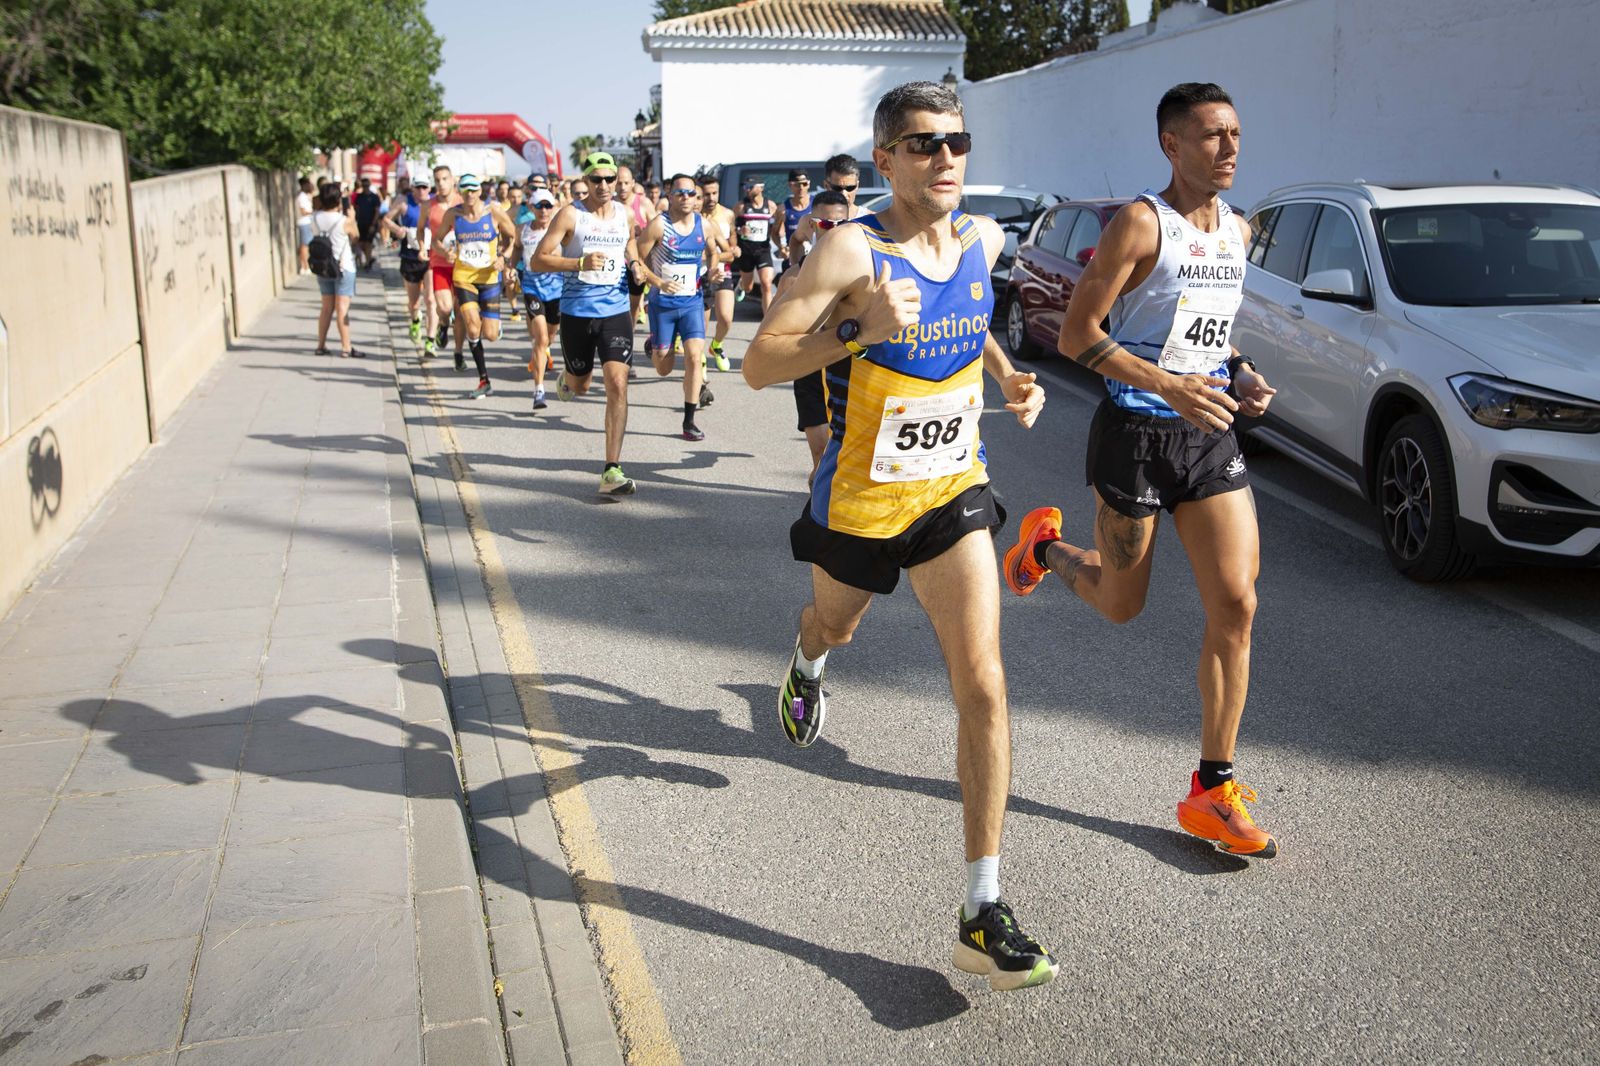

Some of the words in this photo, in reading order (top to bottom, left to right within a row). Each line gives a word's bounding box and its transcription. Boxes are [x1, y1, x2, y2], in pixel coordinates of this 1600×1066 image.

[465, 249, 484, 259] 597
[672, 274, 686, 284] 21
[1177, 264, 1243, 281] MARACENA
[1184, 317, 1229, 349] 465
[907, 340, 977, 360] GRANADA
[895, 416, 963, 450] 598
